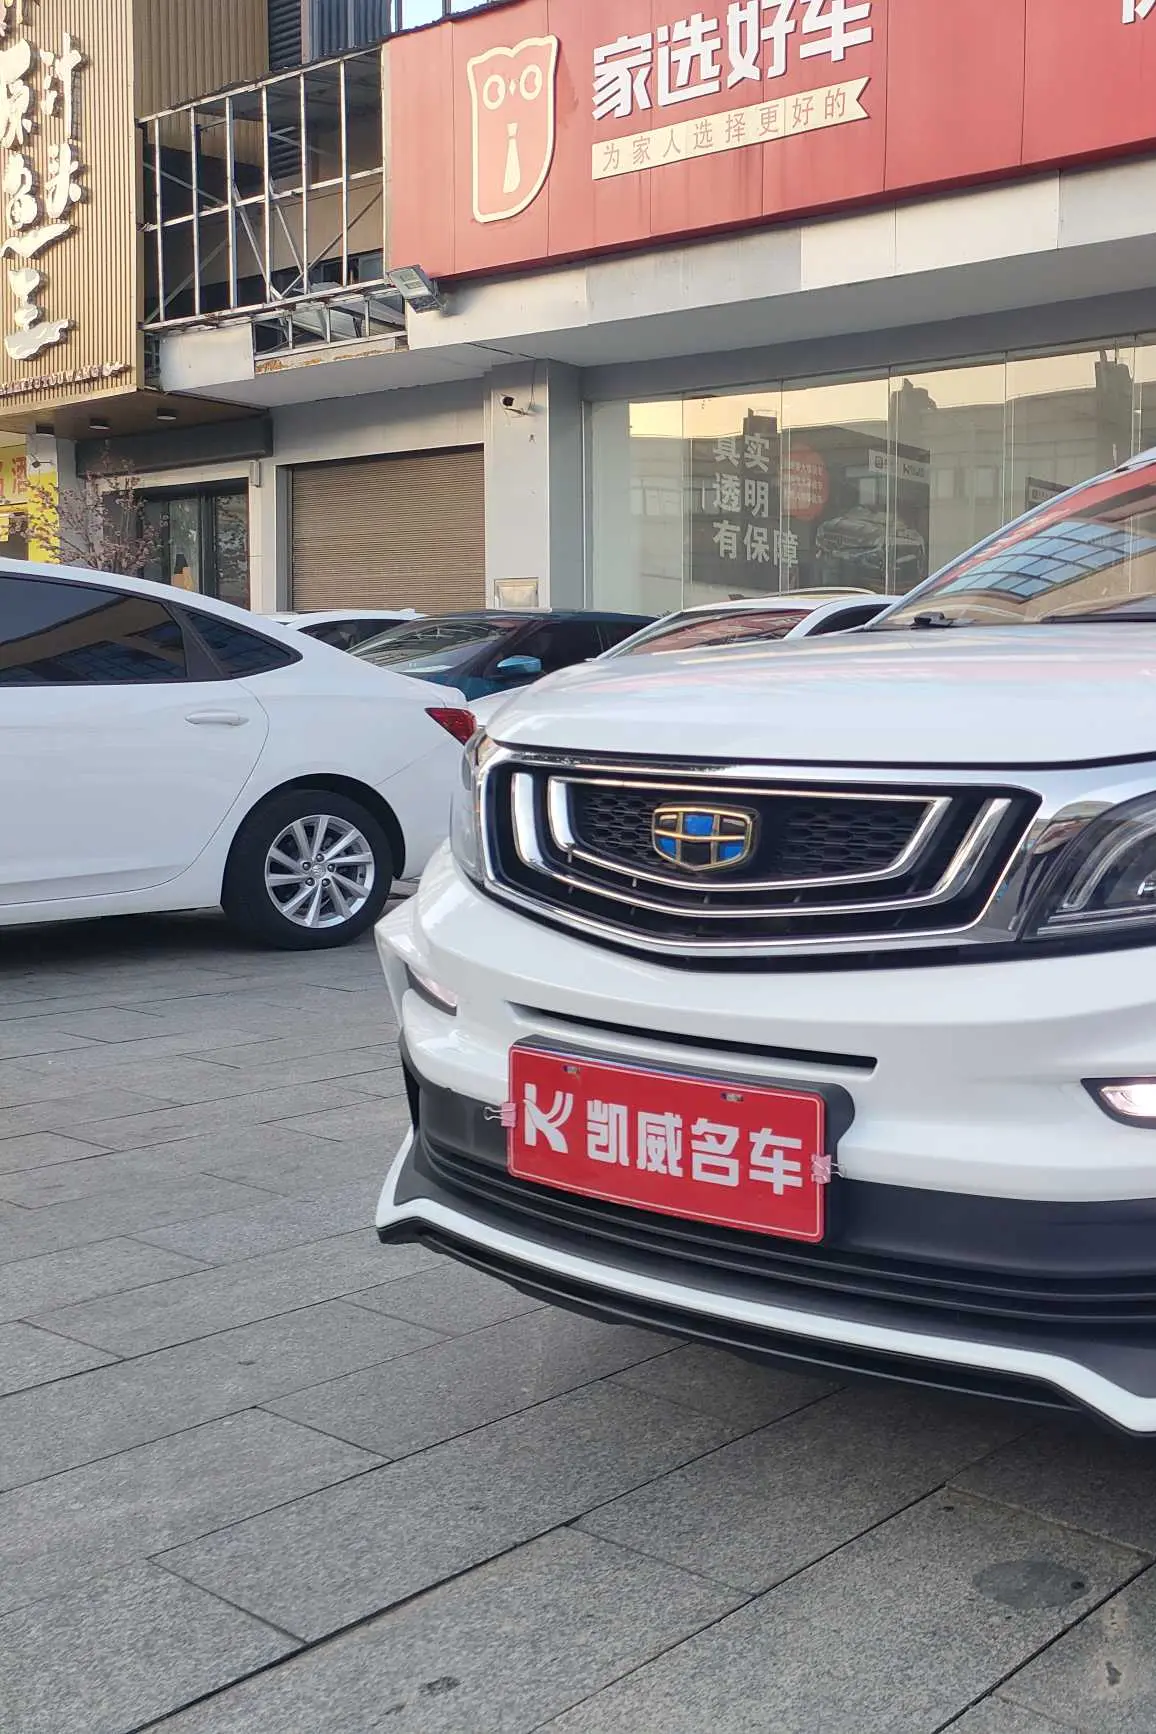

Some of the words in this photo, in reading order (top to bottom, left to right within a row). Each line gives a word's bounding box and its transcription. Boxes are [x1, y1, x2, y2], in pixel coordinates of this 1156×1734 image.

[592, 0, 873, 120] 家选好车
[602, 88, 847, 172] 为家人选择更好的
[713, 472, 769, 518] 透明
[713, 519, 799, 568] 有保障
[586, 1099, 803, 1195] 凯威名车
